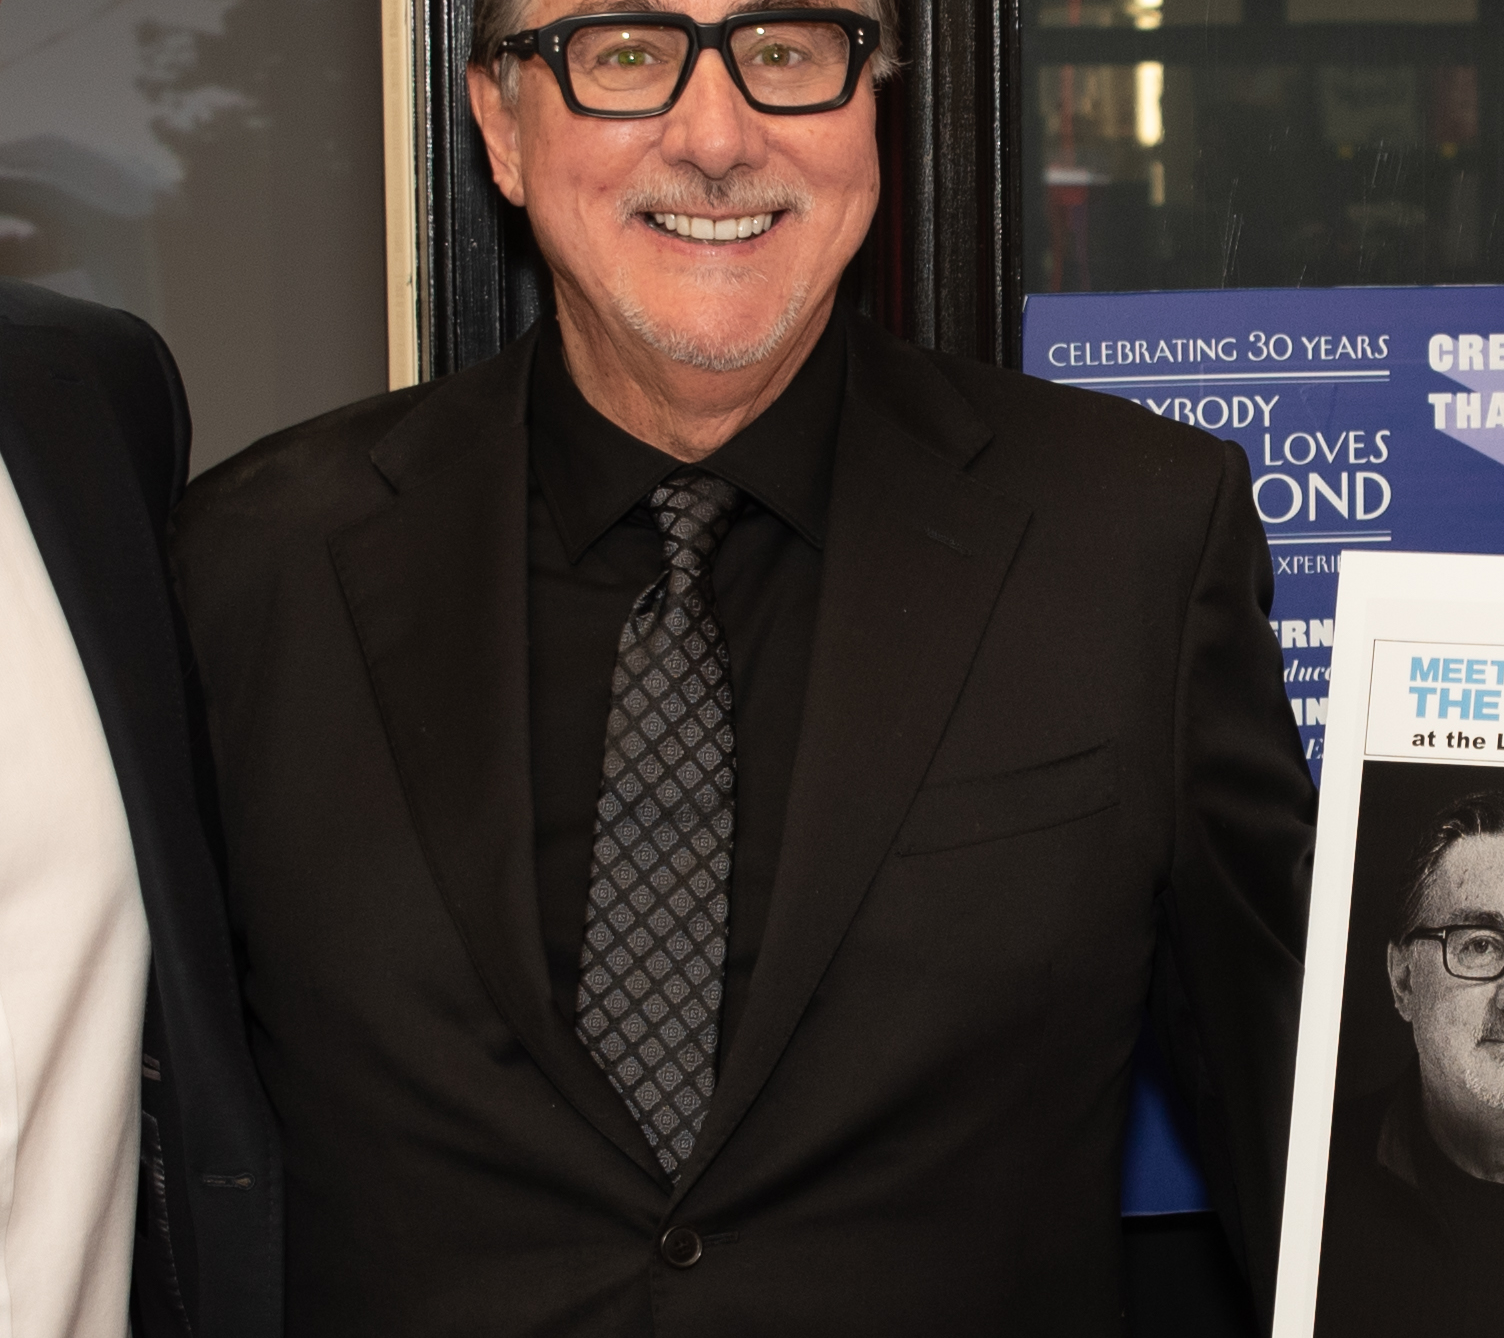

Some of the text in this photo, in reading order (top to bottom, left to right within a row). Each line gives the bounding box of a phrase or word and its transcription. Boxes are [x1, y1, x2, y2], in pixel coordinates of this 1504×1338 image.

[1049, 331, 1389, 366] CELEBRATING 30 YEARS
[1263, 429, 1391, 466] LOVES
[1409, 686, 1504, 722] THE
[1412, 730, 1435, 747] at
[1447, 731, 1485, 749] the
